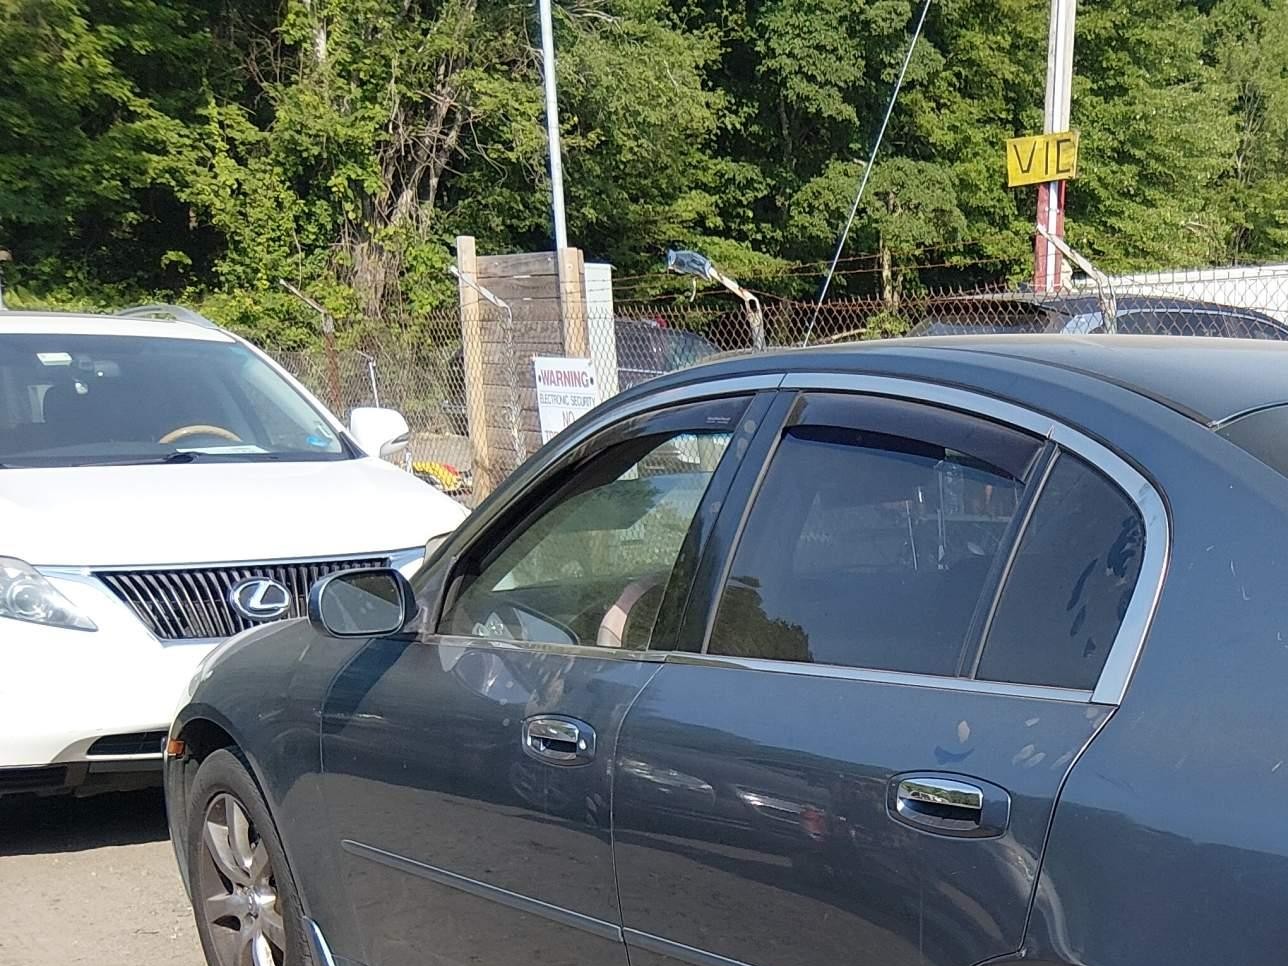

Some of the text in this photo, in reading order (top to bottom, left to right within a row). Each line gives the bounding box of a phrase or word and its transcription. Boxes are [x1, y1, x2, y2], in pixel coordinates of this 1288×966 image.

[541, 369, 589, 388] WARNING
[539, 393, 596, 408] ELECTRONIC SECURITY
